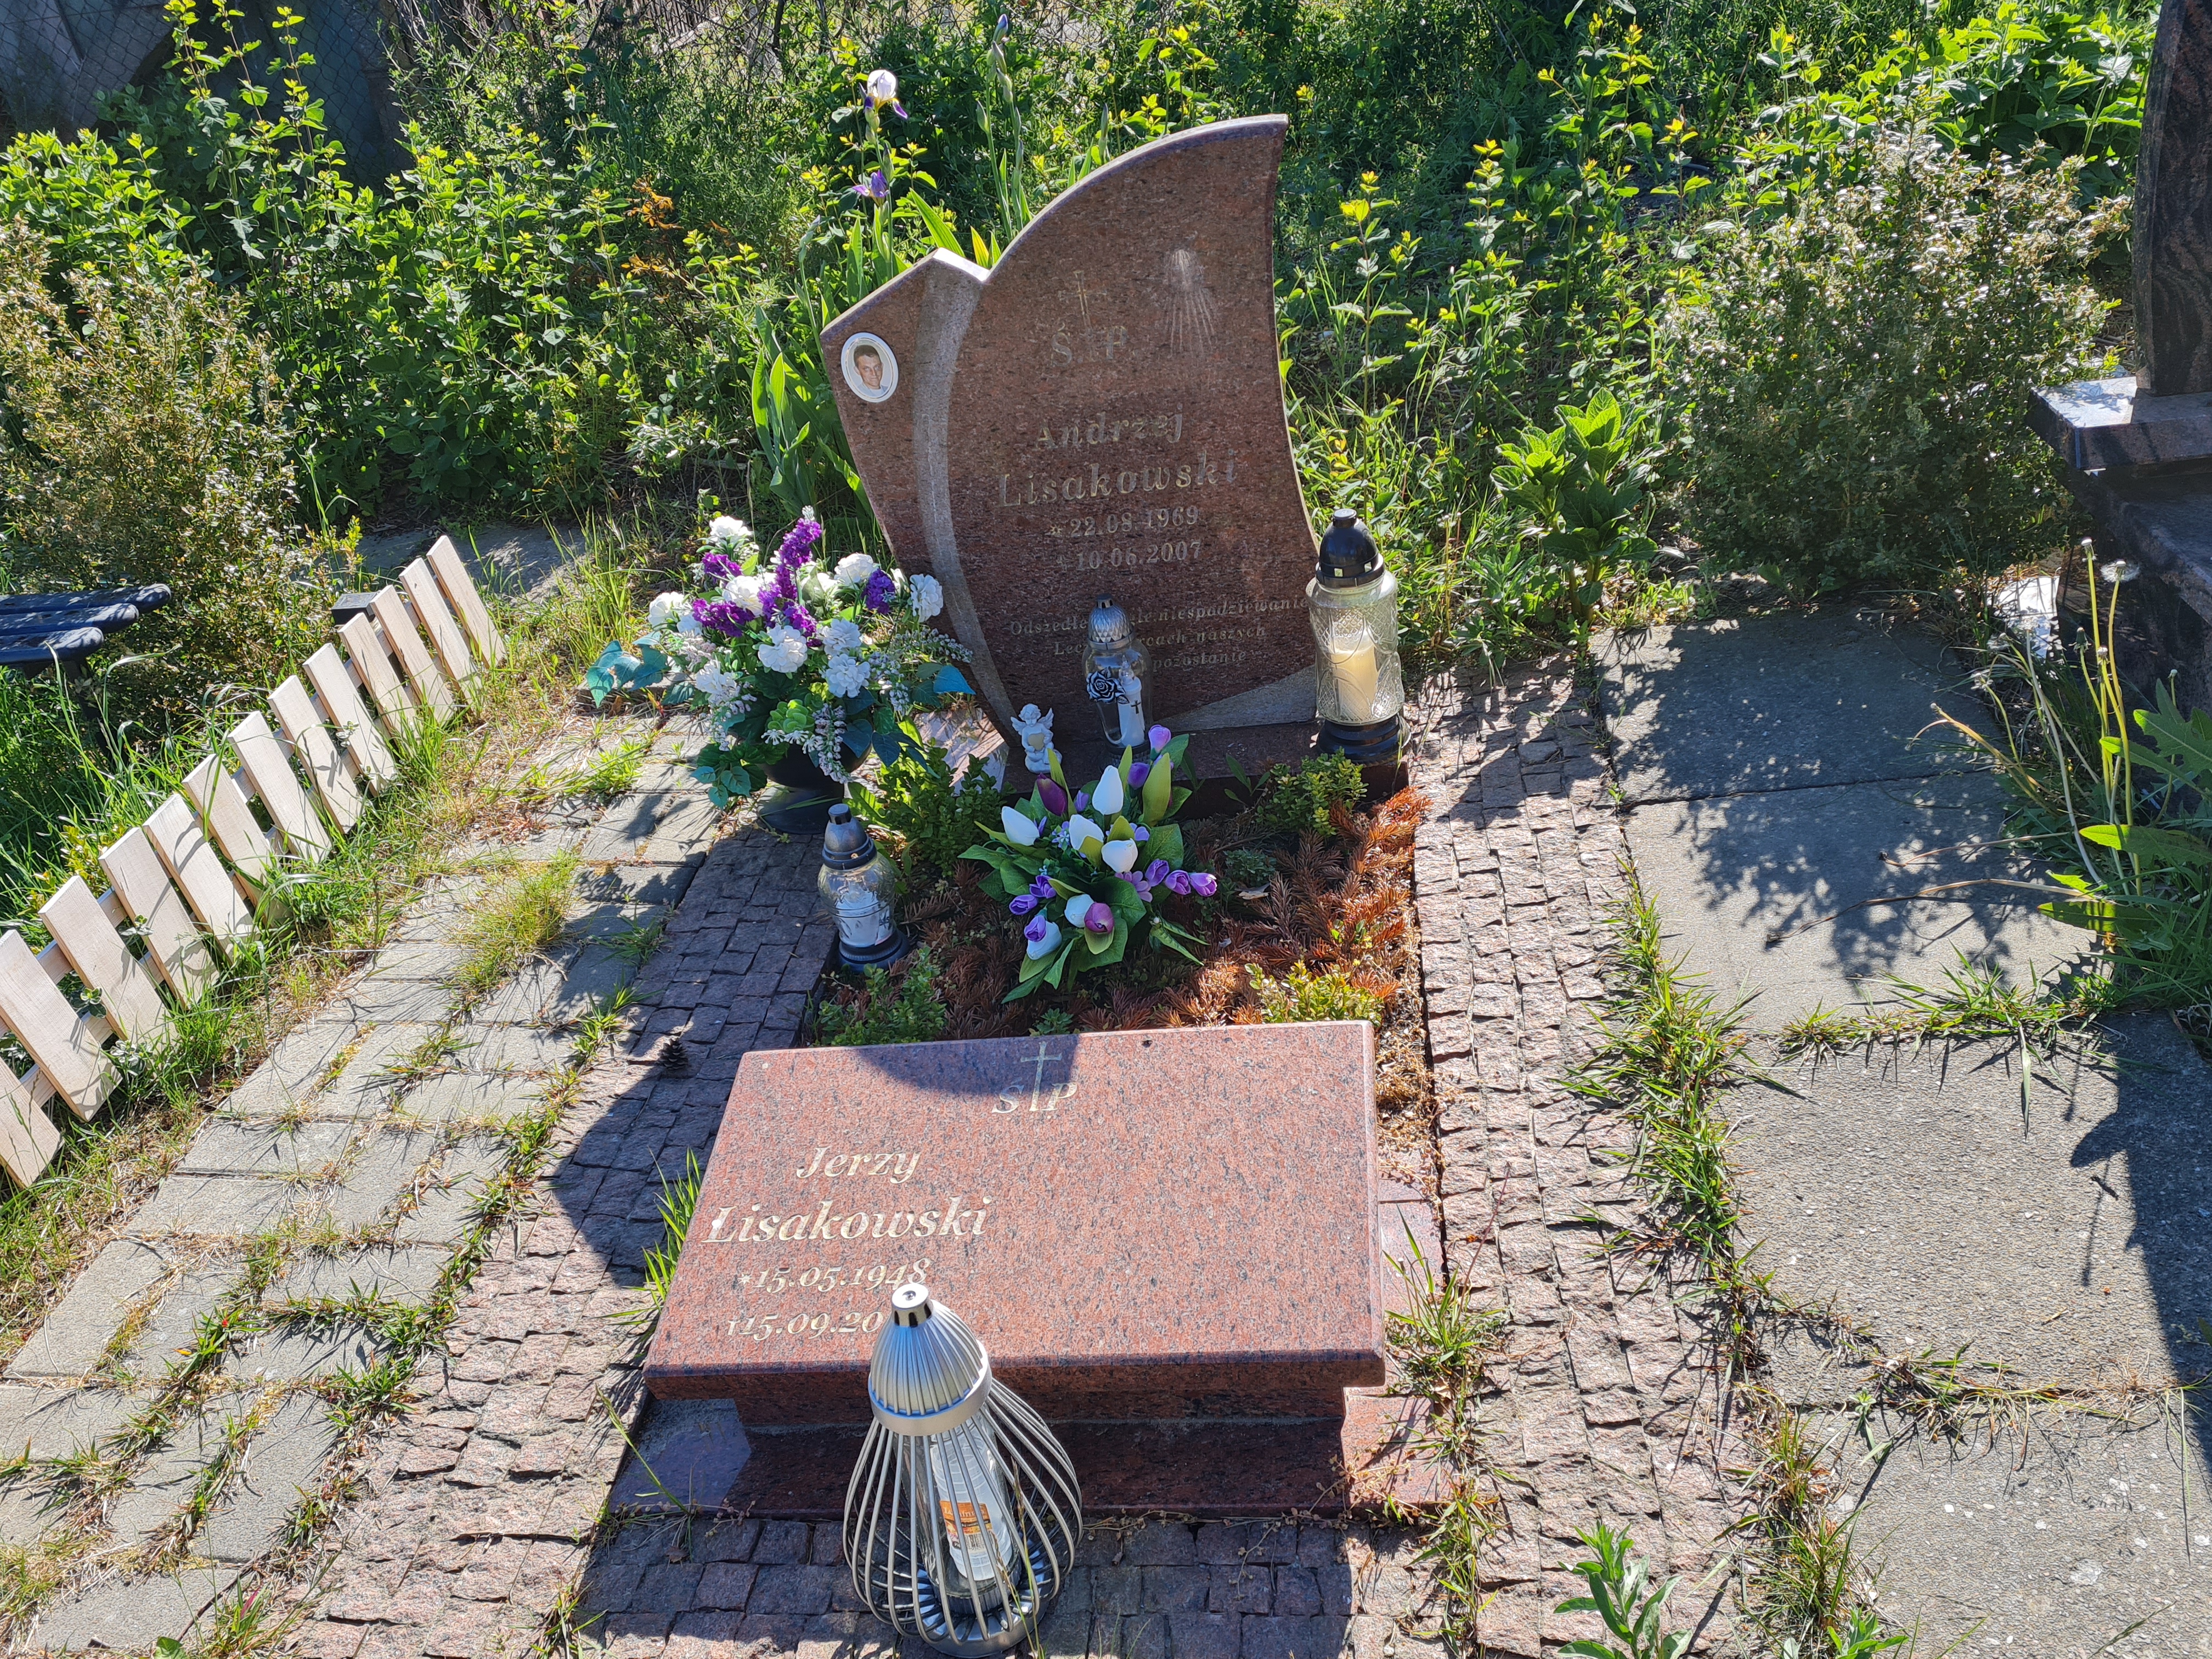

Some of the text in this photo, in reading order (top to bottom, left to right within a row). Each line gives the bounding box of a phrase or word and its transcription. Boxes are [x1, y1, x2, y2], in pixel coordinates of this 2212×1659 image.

[1035, 402, 1183, 450] Andrzej
[996, 448, 1238, 507] Lisakowski
[1010, 615, 1088, 635] Odszedłe
[1196, 624, 1267, 643] naszych
[1153, 651, 1246, 672] pozostanie
[795, 1146, 921, 1184] Jerzy
[701, 1195, 992, 1243] Lisakowski
[752, 1258, 931, 1294] 15.05.1948
[738, 1311, 883, 1341] 15.09.20
